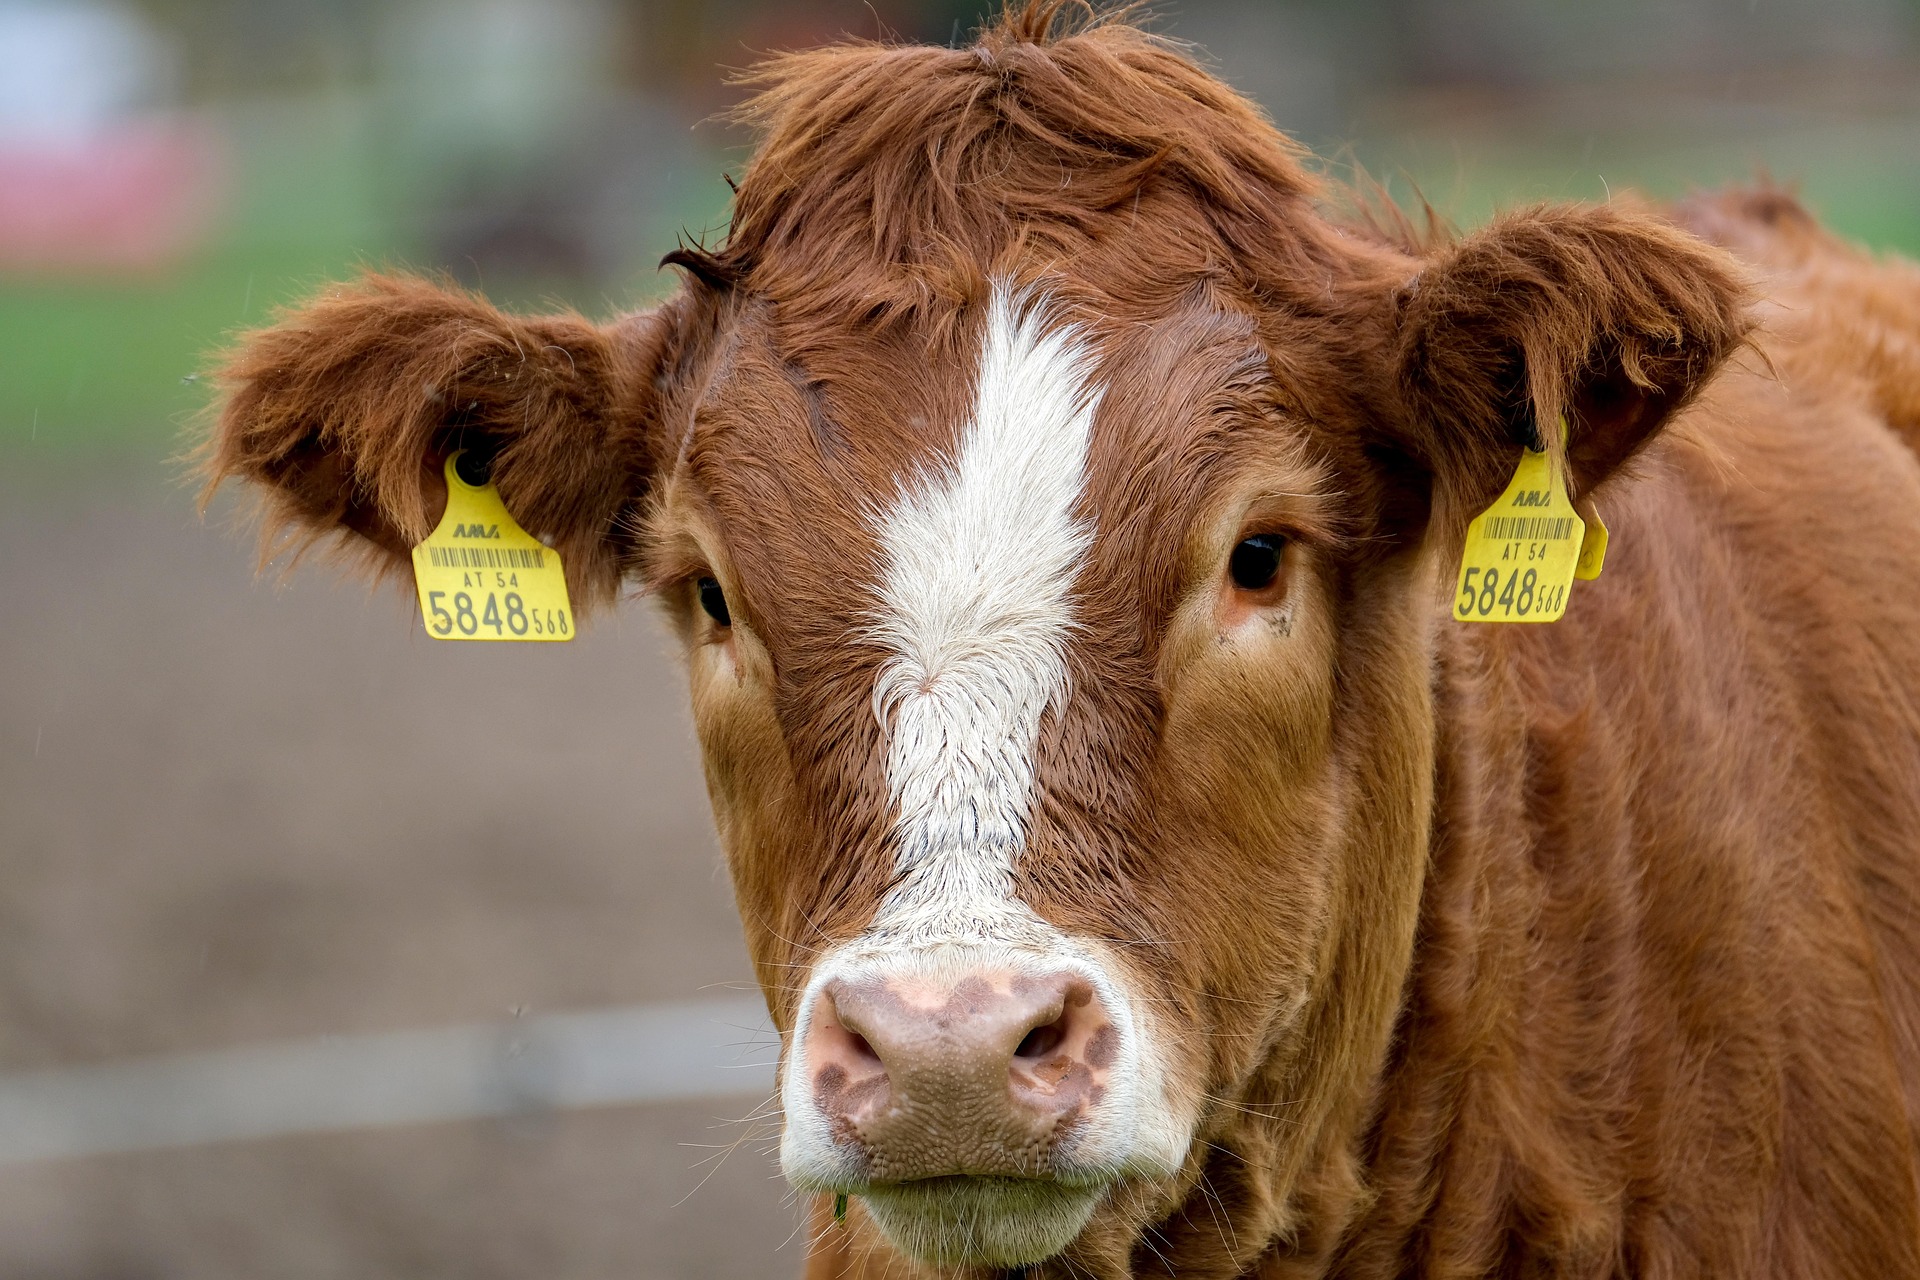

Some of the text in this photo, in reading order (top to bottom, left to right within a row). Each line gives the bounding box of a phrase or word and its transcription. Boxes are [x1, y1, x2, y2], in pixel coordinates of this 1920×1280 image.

[453, 523, 500, 539] AMA
[1502, 542, 1547, 561] AT 54
[464, 571, 519, 588] AT 54
[1458, 566, 1564, 616] 5848 568
[428, 591, 568, 636] 5848 568
